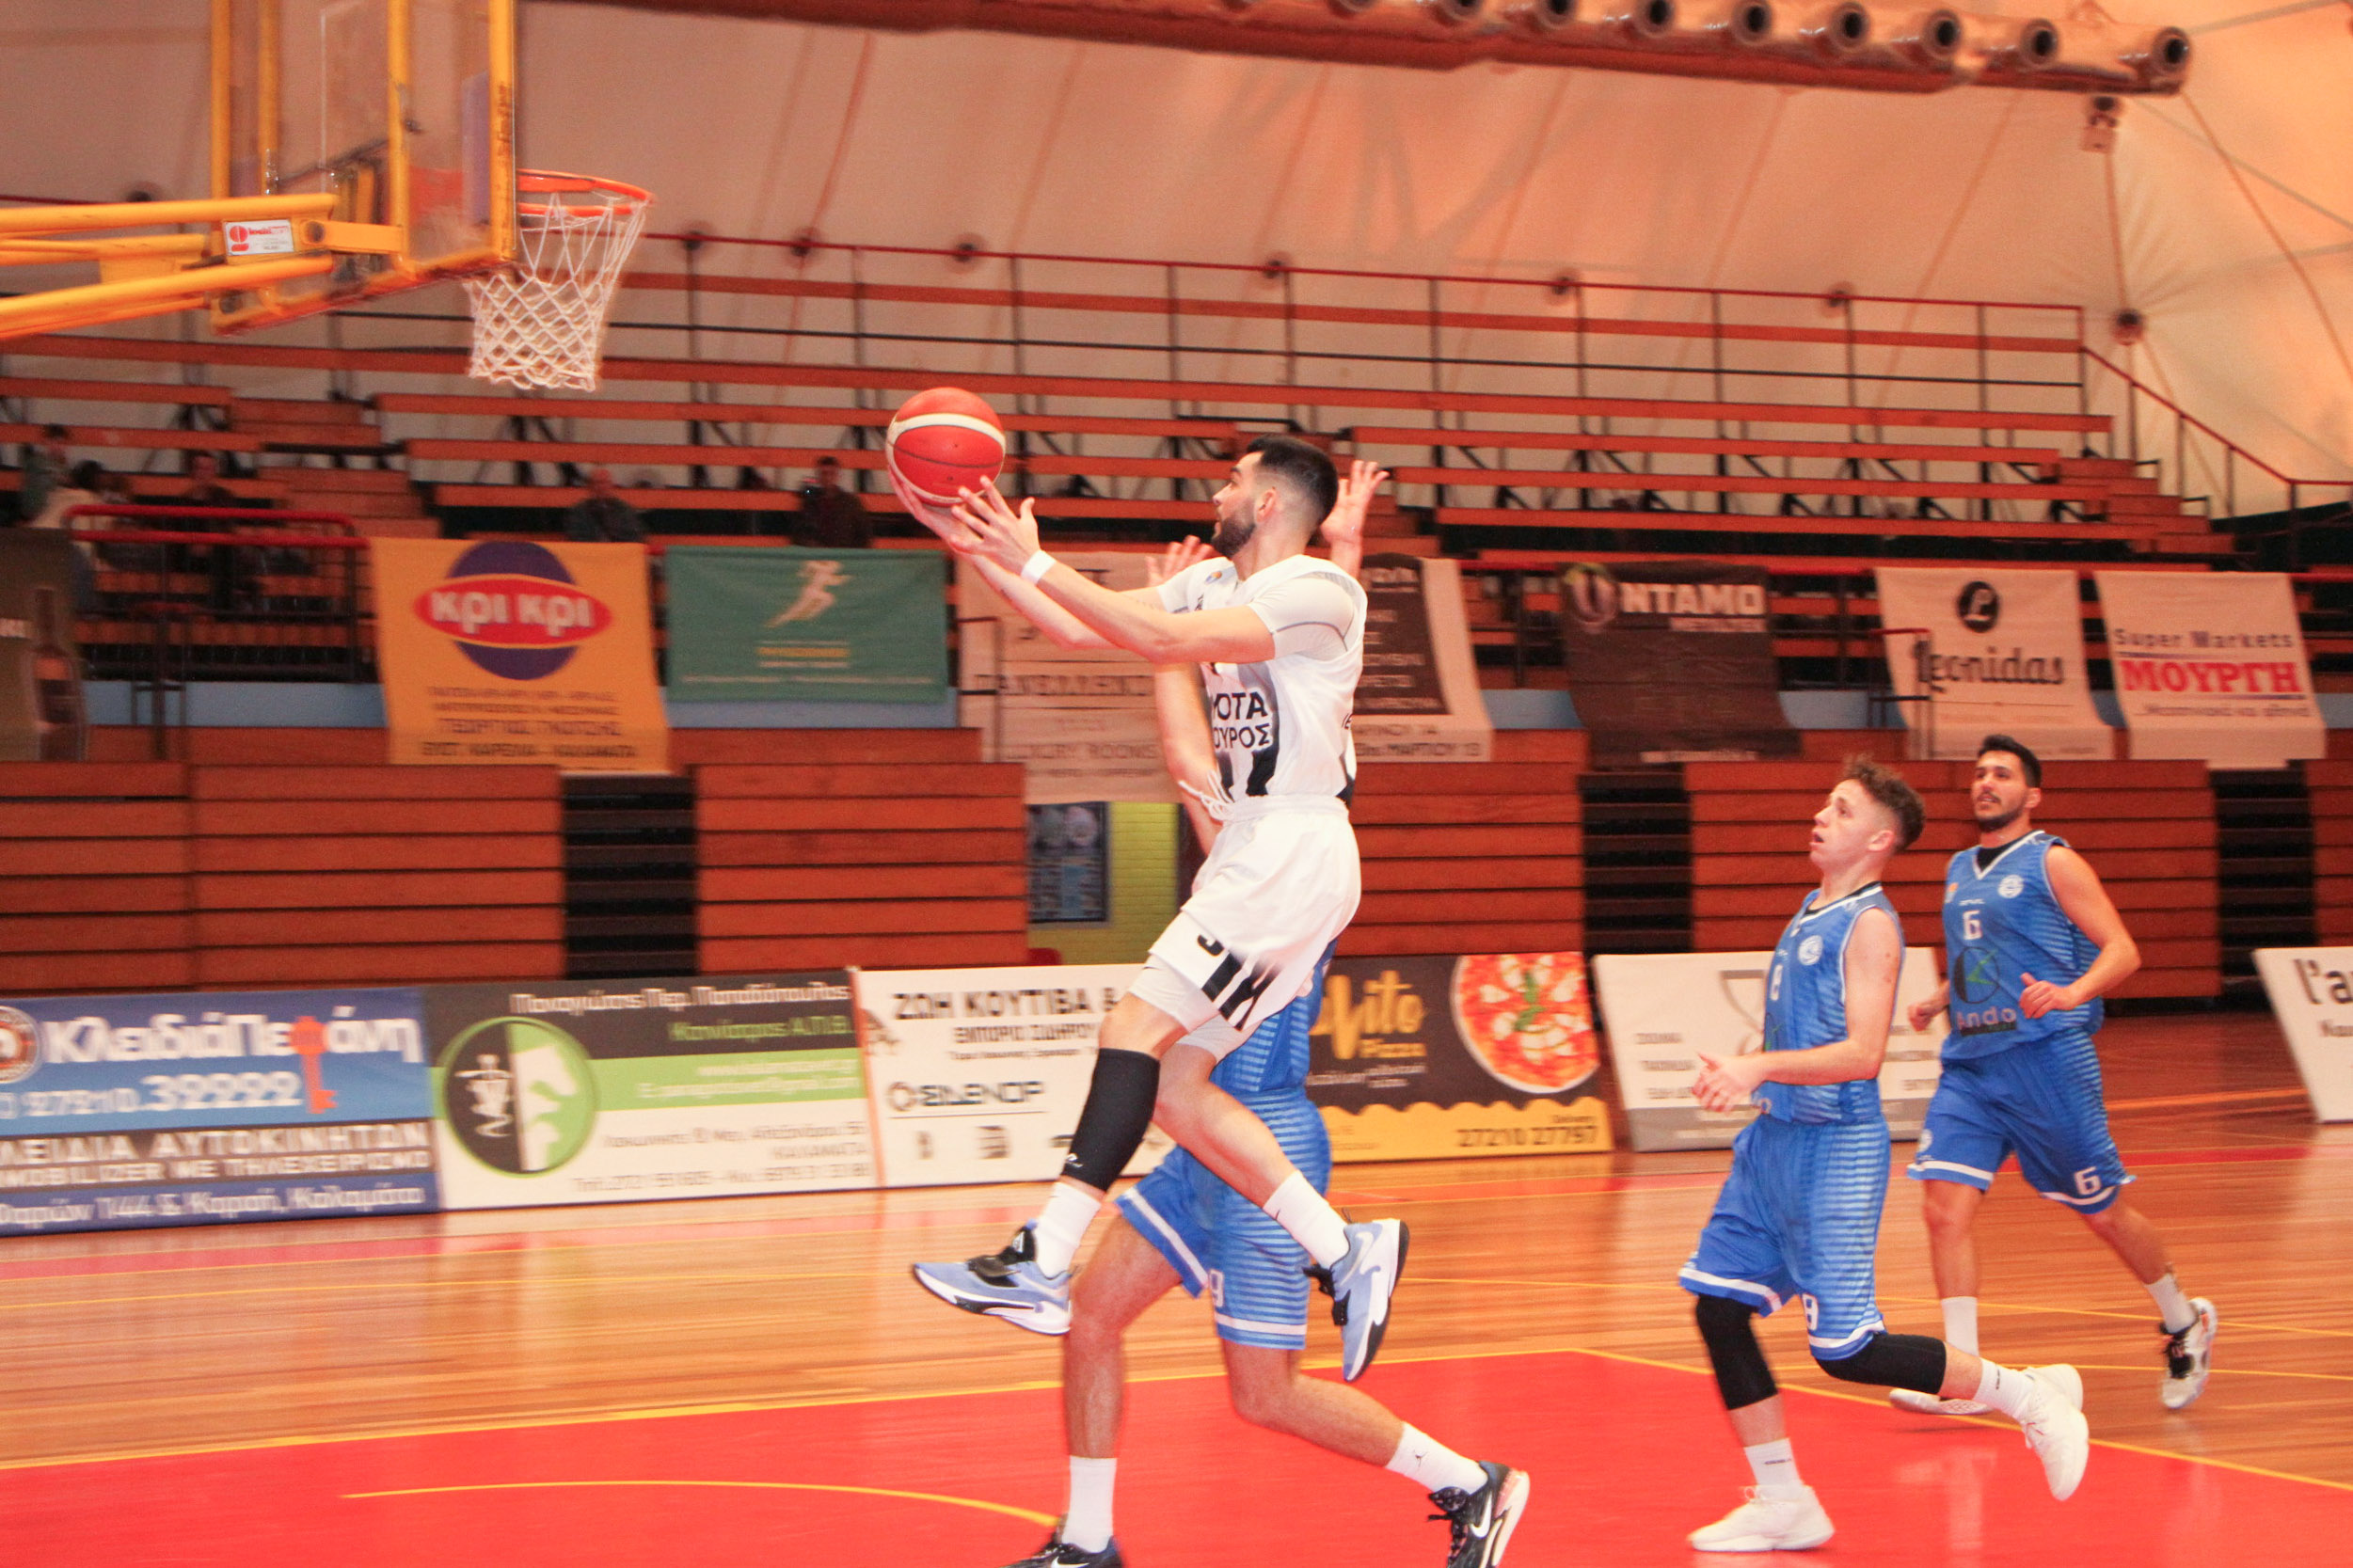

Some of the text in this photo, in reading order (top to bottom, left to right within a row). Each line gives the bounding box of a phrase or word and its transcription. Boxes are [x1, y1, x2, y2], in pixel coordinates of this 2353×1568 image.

[2119, 660, 2303, 693] ΜΟΥΡΓΗ
[1963, 910, 1983, 941] 6
[894, 991, 954, 1020] ΖΩΗ
[963, 989, 1095, 1018] ΚΟΥΤΙΒΑ
[2074, 1165, 2103, 1196] 6
